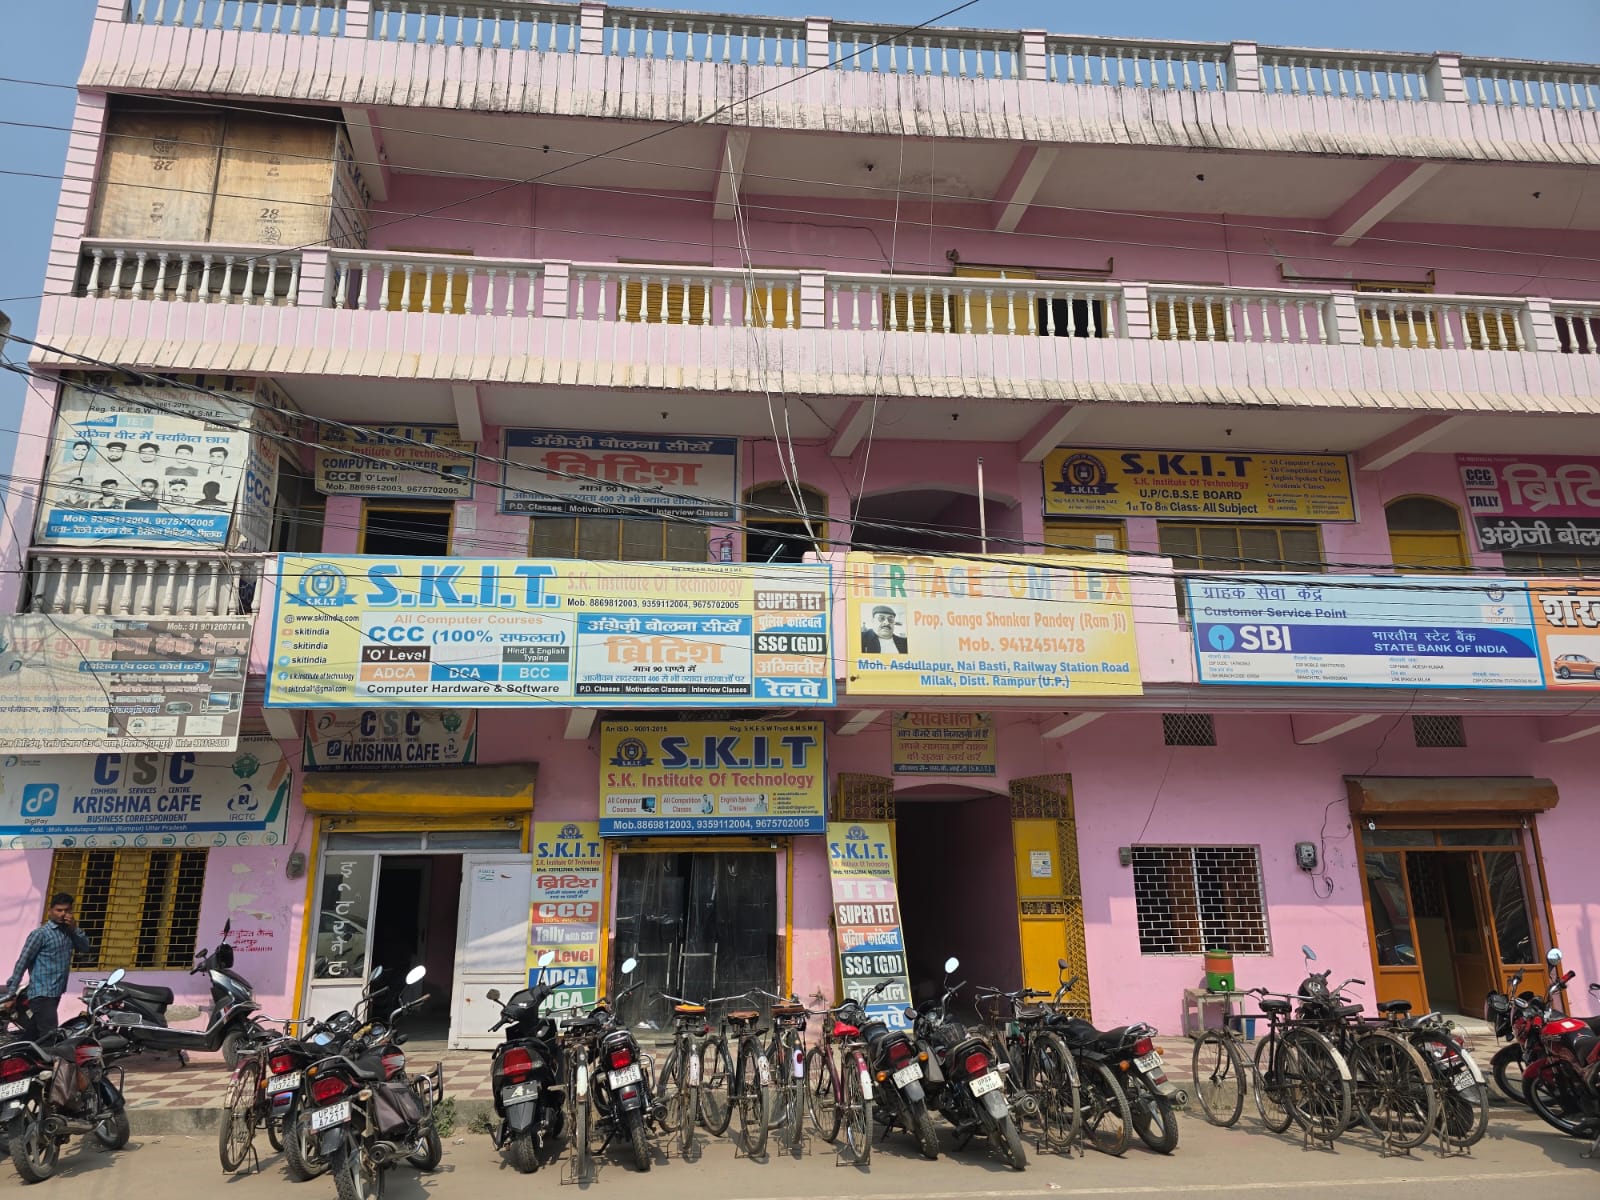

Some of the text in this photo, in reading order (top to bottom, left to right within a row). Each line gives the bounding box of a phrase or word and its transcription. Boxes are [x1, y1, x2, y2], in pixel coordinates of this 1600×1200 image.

[260, 208, 280, 219] 28
[115, 431, 137, 441] वीर
[139, 431, 154, 442] में
[599, 437, 660, 451] बोलना
[323, 458, 387, 471] COMPUTER
[1120, 453, 1253, 478] S.K.I.T
[329, 472, 398, 483] CCC Level
[1466, 469, 1491, 480] CCC
[1152, 478, 1250, 490] Institute Technology
[1203, 490, 1242, 501] BOARD
[1469, 496, 1498, 507] TALLY
[528, 503, 563, 512] Classes
[569, 503, 615, 514] Motivation
[656, 508, 729, 518] Interview Classes
[1140, 501, 1153, 512] To
[1203, 502, 1217, 513] All
[1218, 503, 1259, 516] Subject
[1482, 520, 1552, 549] अंग्रेजी
[366, 564, 562, 609] S.K.I.T.
[597, 572, 744, 597] Institute Of Technology
[1202, 586, 1245, 601] ग्राहक
[1254, 585, 1286, 600] सेवा
[567, 597, 588, 608] Mob.
[589, 598, 641, 610] 8869812003,
[693, 600, 740, 611] 9675702005
[758, 593, 822, 610] SUPER TET
[1204, 606, 1347, 619] Customer Service Point
[394, 615, 544, 628] All Computer Courses
[646, 617, 698, 632] बोलना
[701, 618, 742, 633] सीखें
[914, 611, 1109, 631] Prop. Ganga Shankar Pandey (Ram
[295, 628, 330, 636] skitindia
[368, 626, 494, 645] CCC (100%
[1240, 625, 1291, 651] SBI
[1372, 629, 1476, 643] भारतीय स्टेट बैंक
[293, 642, 328, 650] skitindia
[604, 635, 728, 664] ब्रिटिश
[758, 636, 823, 652] SSC (GD)
[958, 637, 1085, 652] Mob. 9412451478
[1374, 643, 1508, 654] STATE BANK OF INDIA
[389, 648, 426, 662] Level
[507, 646, 566, 657] Hindi English
[524, 653, 549, 663] Typing
[292, 656, 327, 664] skitindia
[858, 659, 888, 670] Moh.
[957, 660, 976, 671] Nai
[979, 661, 1010, 674] Basti,
[1013, 661, 1057, 675] Railway
[1060, 662, 1099, 673] Station
[1102, 662, 1129, 673] Road
[373, 667, 416, 680] ADCA
[450, 667, 480, 680] DCA
[520, 667, 551, 680] BCC
[367, 684, 560, 695] Computer Hardware & Software
[761, 678, 821, 697] रेलवे
[920, 675, 1070, 690] Milak, Distt. Rampur (U.P.)
[594, 686, 620, 694] Classes
[625, 686, 686, 694] Motivation Classes
[911, 712, 973, 727] सावधान
[343, 744, 440, 762] KRISHNA CAFE
[660, 736, 817, 769] S.K.I.T
[607, 773, 814, 789] S.K. Institute Of Technology
[73, 795, 201, 813] KRISHNA CAFE
[87, 814, 187, 823] BUSINESS CORRESPONDENT
[696, 819, 810, 830] 9359112004, 9675702005
[537, 843, 600, 858] S.K.I.T.
[830, 843, 888, 859] S.K.I.T.
[536, 875, 599, 890] ब्रिटिश
[838, 881, 887, 899] TET
[539, 903, 593, 917] CCC
[839, 904, 894, 924] SUPER TET
[536, 926, 565, 943] Tally
[554, 949, 594, 963] Level
[845, 955, 903, 975] SSC (GD)
